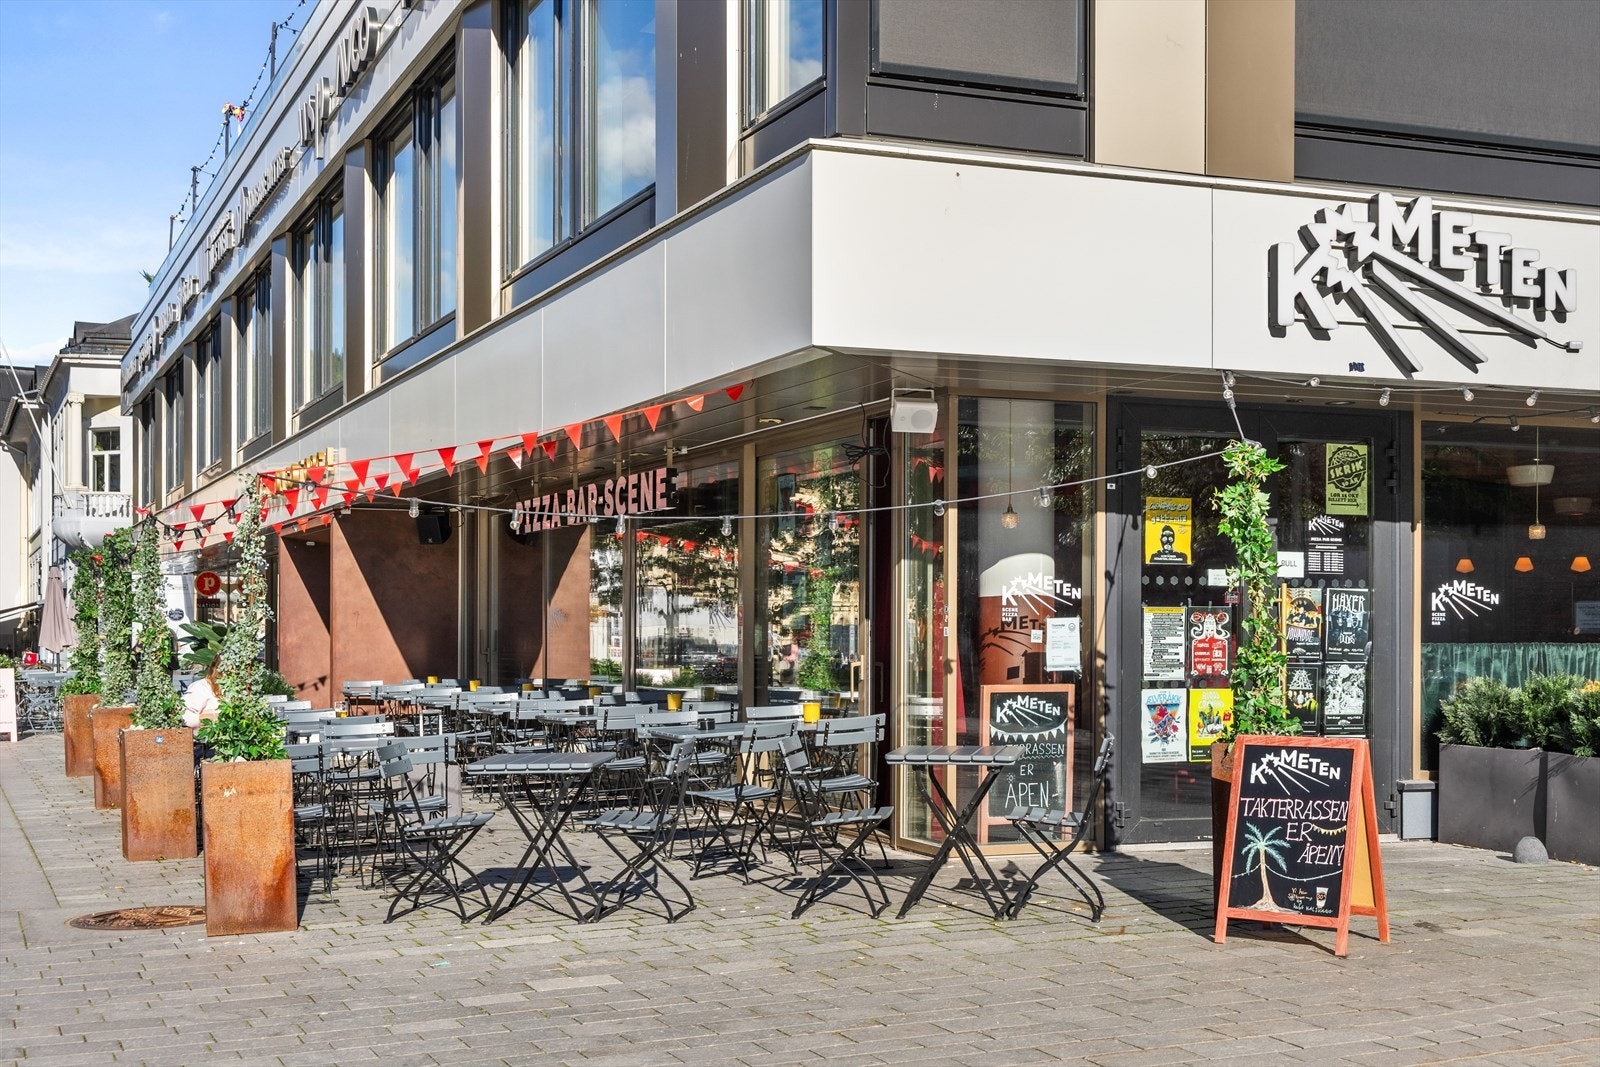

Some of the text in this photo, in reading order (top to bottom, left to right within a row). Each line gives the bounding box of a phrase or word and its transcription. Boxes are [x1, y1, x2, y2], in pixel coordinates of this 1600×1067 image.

[1329, 460, 1364, 479] SKRIK
[1020, 763, 1034, 776] ER
[1240, 797, 1349, 822] TAKTERRASSEN
[1285, 821, 1313, 842] ER
